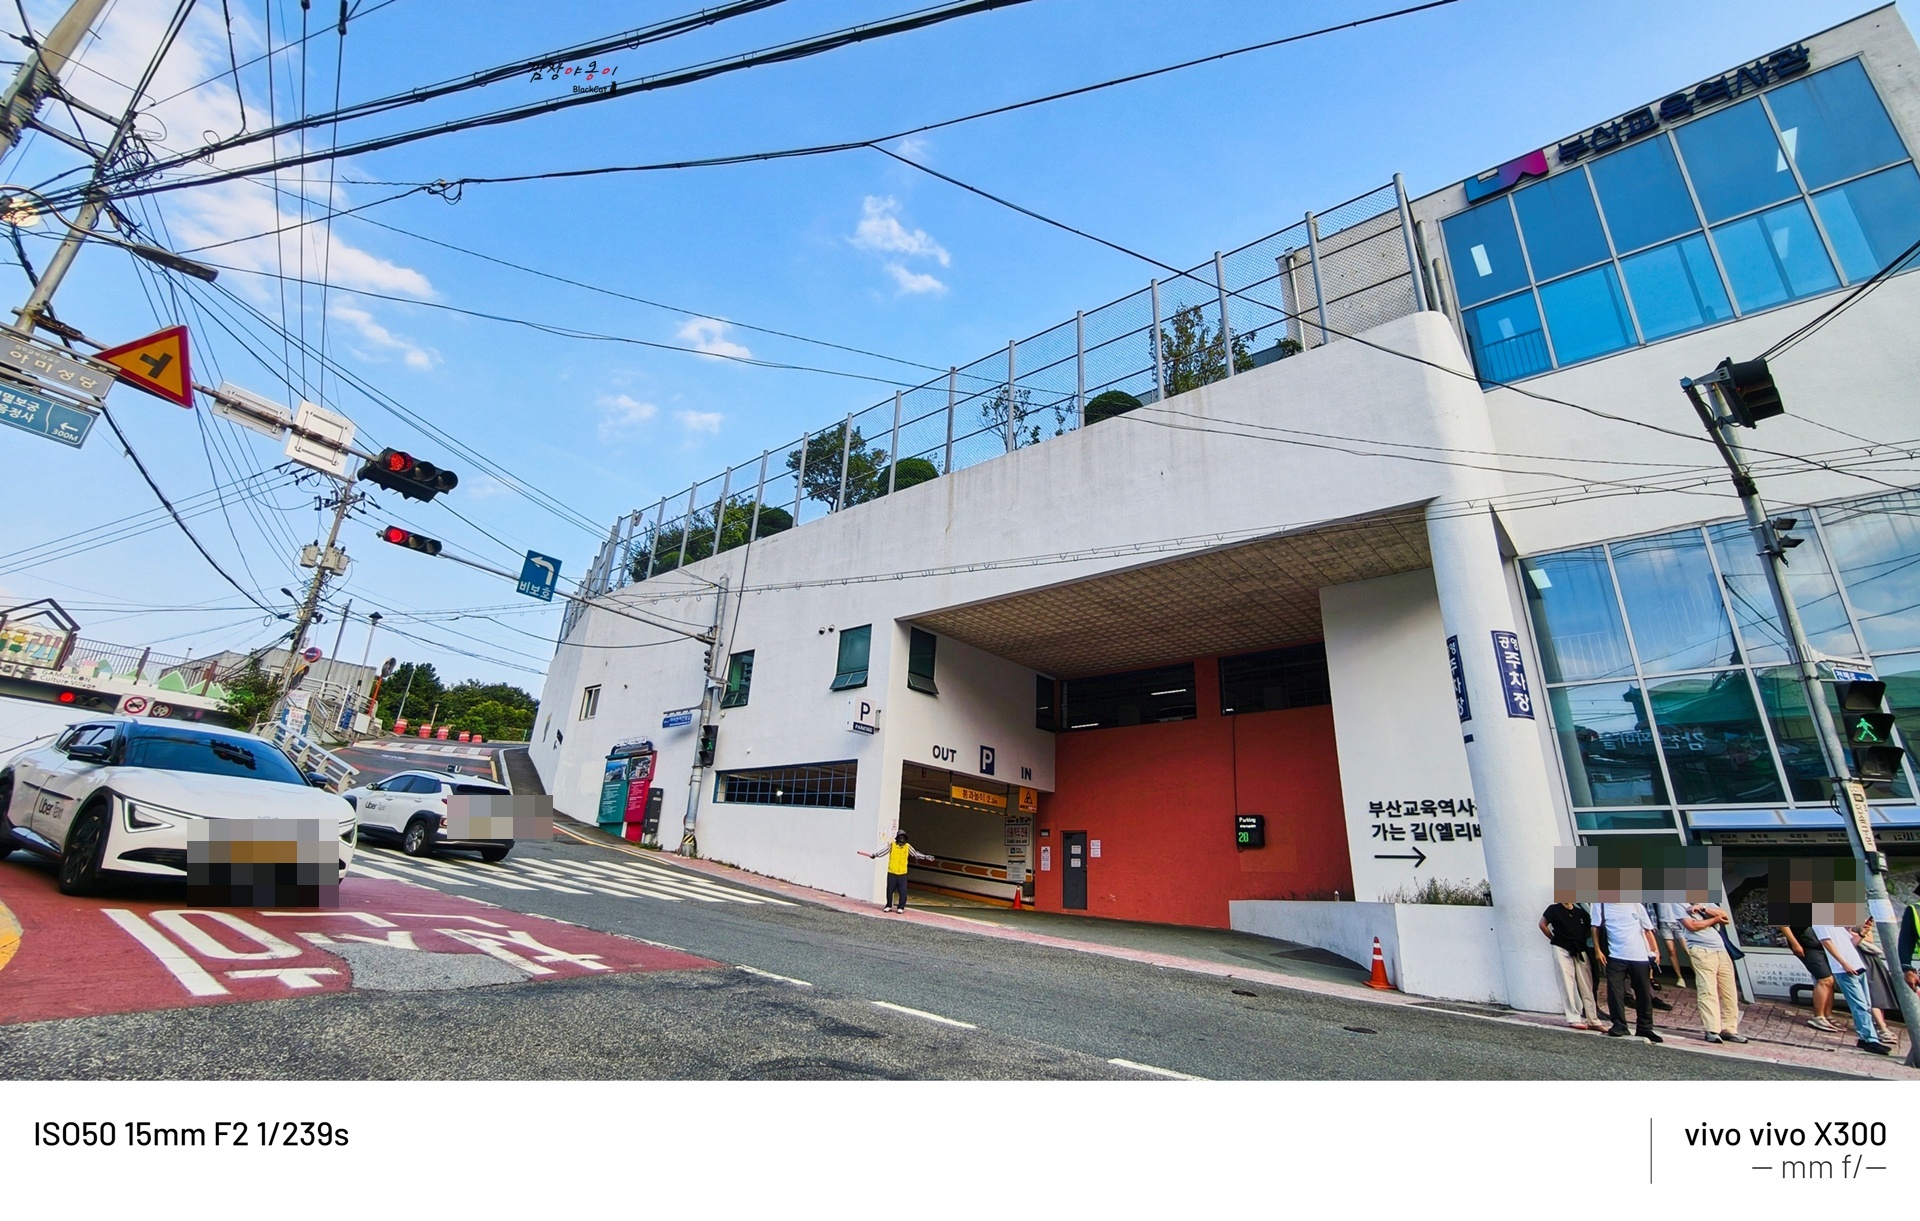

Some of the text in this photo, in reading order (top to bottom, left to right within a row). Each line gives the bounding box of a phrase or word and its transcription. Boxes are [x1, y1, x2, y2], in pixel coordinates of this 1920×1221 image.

[1558, 43, 1811, 163] 부산교육역사관
[10, 350, 98, 390] 아미성당
[0, 390, 40, 412] 멸보궁
[51, 428, 79, 442] 300M
[519, 581, 552, 600] 비보호
[40, 675, 96, 690] Culture Village
[42, 669, 91, 683] GAMCHEON
[1504, 651, 1530, 712] 주차장
[861, 701, 871, 721] P
[932, 745, 957, 763] OUT
[982, 749, 993, 770] P
[1021, 766, 1032, 780] IN
[38, 797, 54, 815] Uber
[365, 801, 378, 810] Uber
[1368, 798, 1477, 818] 부산교육역사
[1372, 822, 1406, 841] 가는
